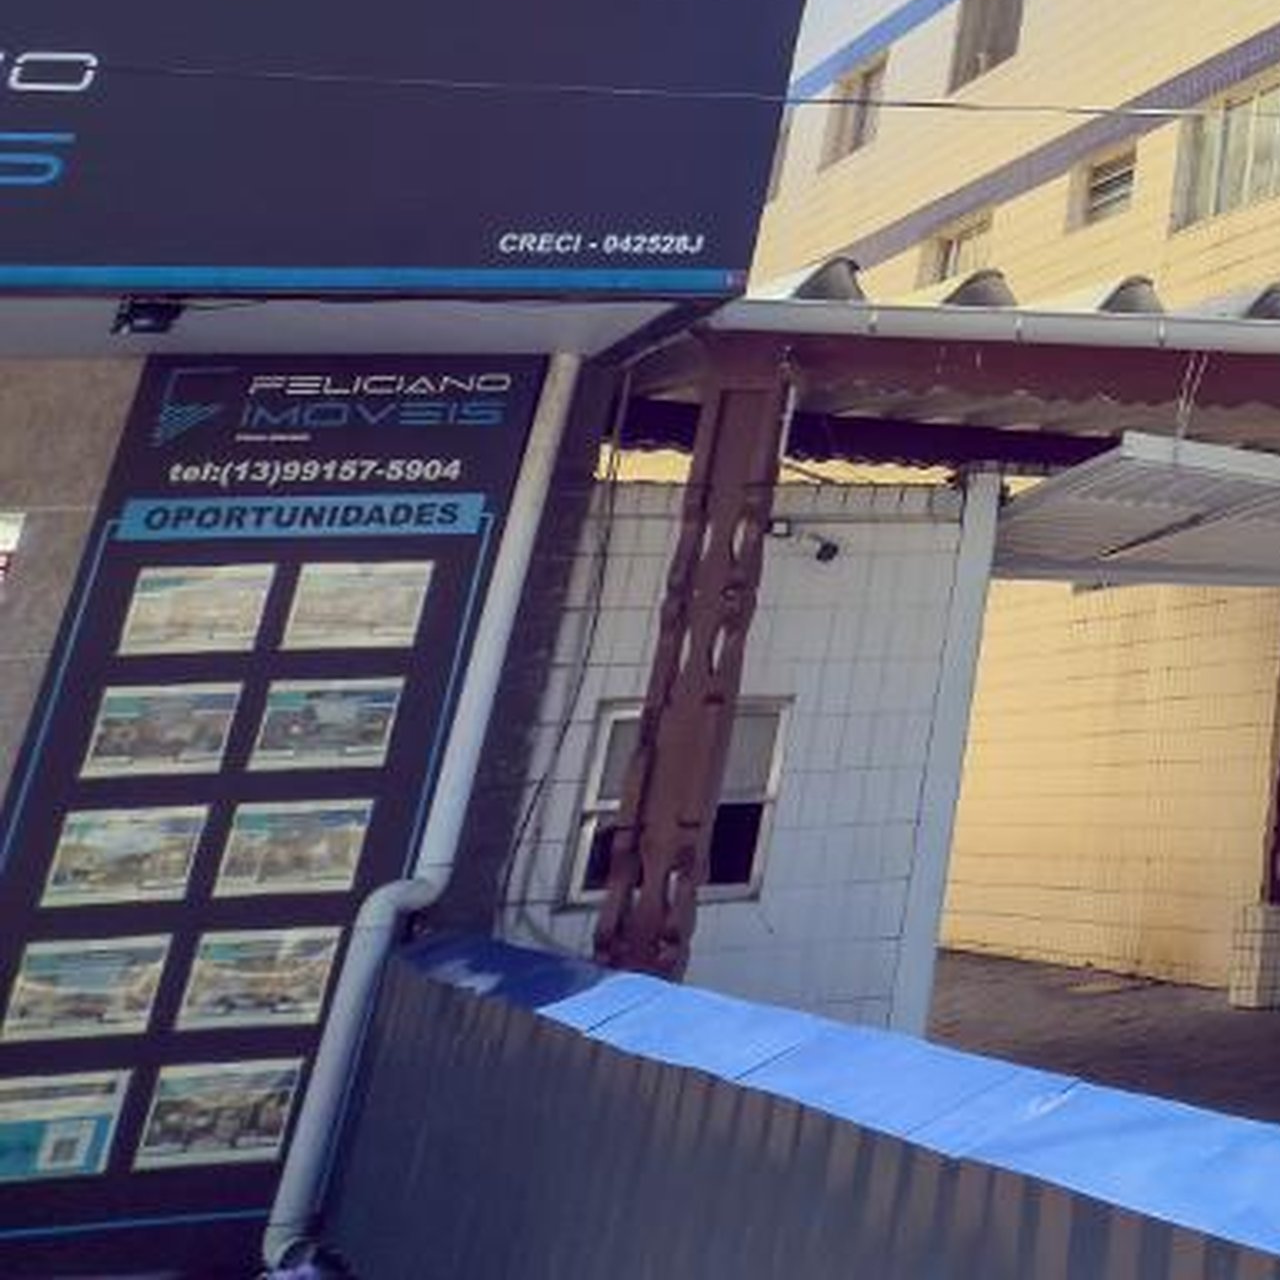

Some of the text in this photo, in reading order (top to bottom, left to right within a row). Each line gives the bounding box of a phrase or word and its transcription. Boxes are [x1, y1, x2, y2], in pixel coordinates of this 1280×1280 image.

[499, 232, 582, 253] CRECI
[248, 373, 512, 396] FELICIANO
[169, 458, 462, 487] tel:(13)99157-5904
[145, 503, 460, 531] OPORTUNIDADES
